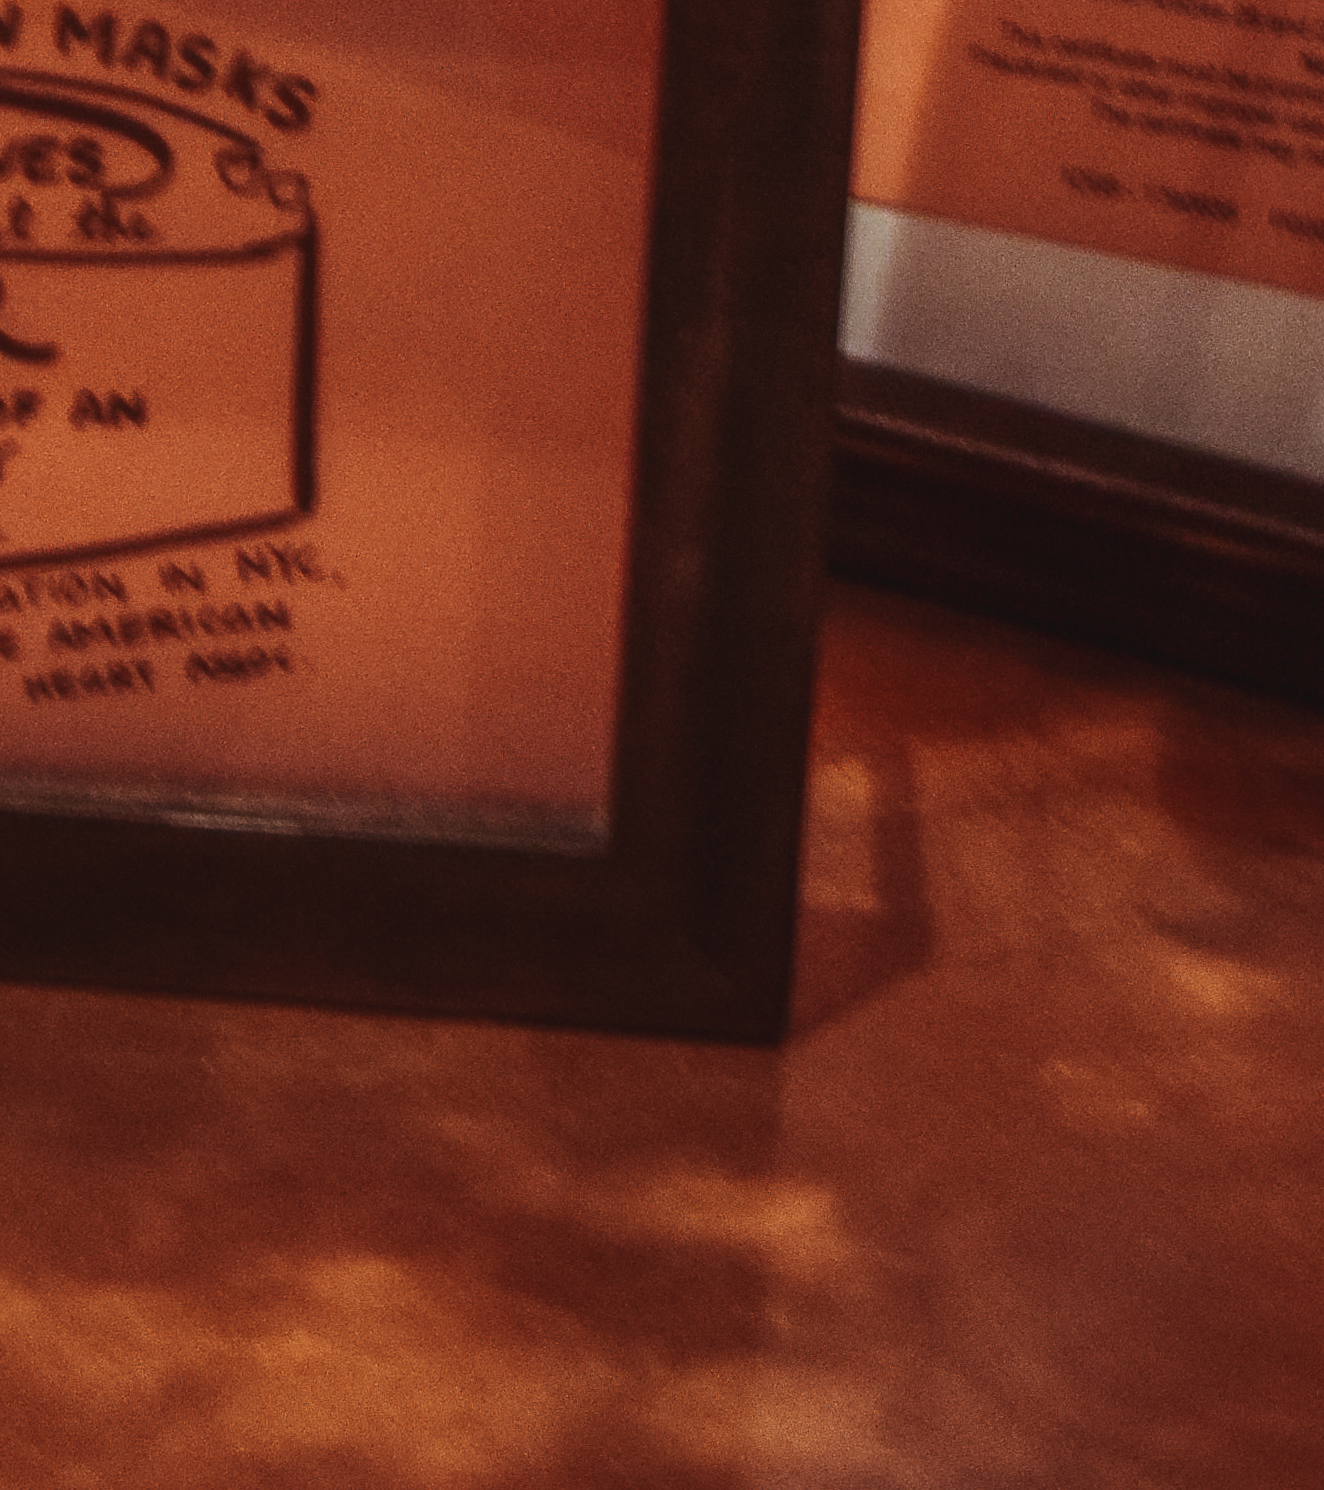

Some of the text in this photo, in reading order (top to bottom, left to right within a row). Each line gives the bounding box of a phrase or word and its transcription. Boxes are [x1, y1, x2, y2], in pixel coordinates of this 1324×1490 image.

[53, 3, 320, 134] MASKS
[68, 386, 149, 432] AN
[157, 560, 208, 596] IN
[49, 597, 293, 652] AMERICAN
